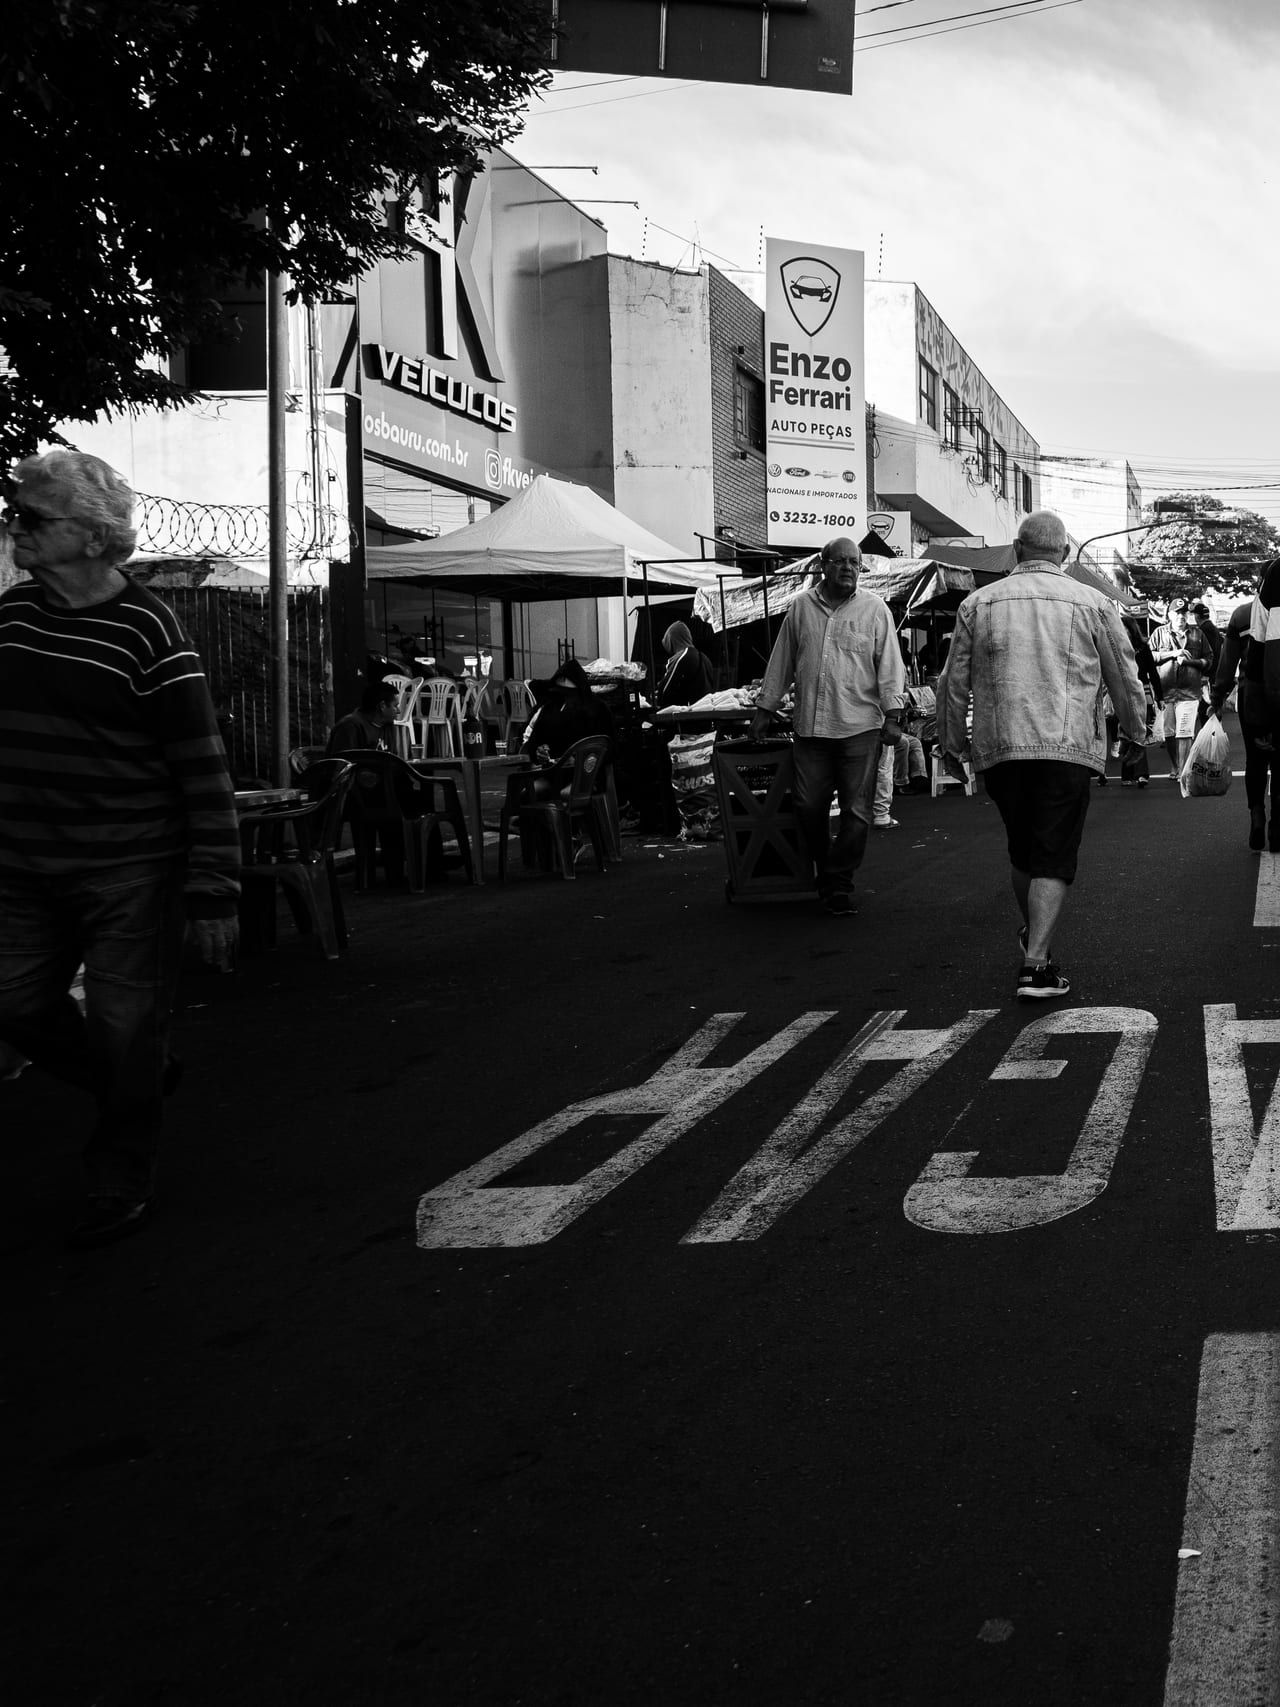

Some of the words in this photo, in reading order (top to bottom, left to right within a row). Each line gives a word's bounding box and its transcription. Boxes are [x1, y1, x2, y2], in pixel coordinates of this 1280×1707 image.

[770, 342, 852, 382] Enzo
[769, 379, 851, 411] Ferrari
[771, 419, 807, 433] AUTO
[811, 423, 852, 439] PEÇAS
[767, 487, 805, 497] NACIONAIS
[812, 491, 858, 500] IMPORTADOS
[782, 511, 856, 527] 3232-1800
